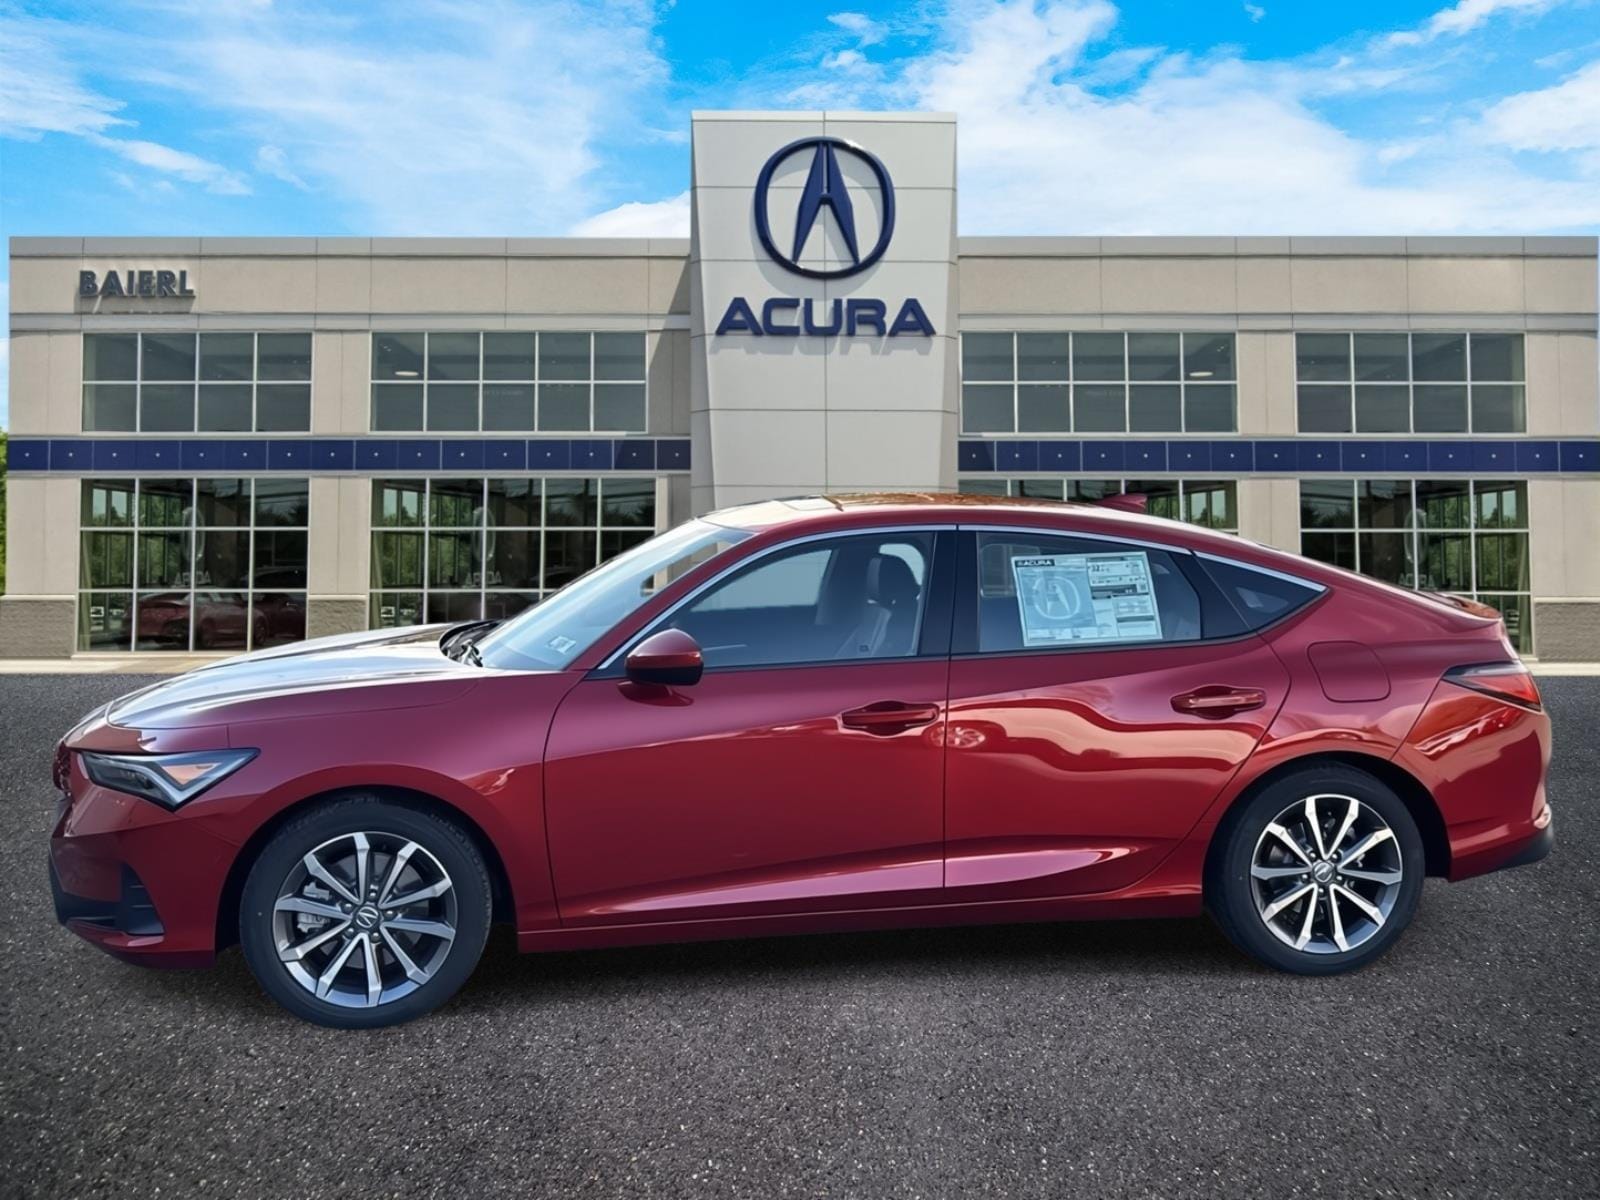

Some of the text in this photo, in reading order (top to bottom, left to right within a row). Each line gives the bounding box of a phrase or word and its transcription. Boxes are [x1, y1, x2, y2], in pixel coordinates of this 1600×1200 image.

[79, 270, 194, 297] BAIERL
[715, 297, 937, 337] ACURA
[1023, 559, 1052, 567] ACURA
